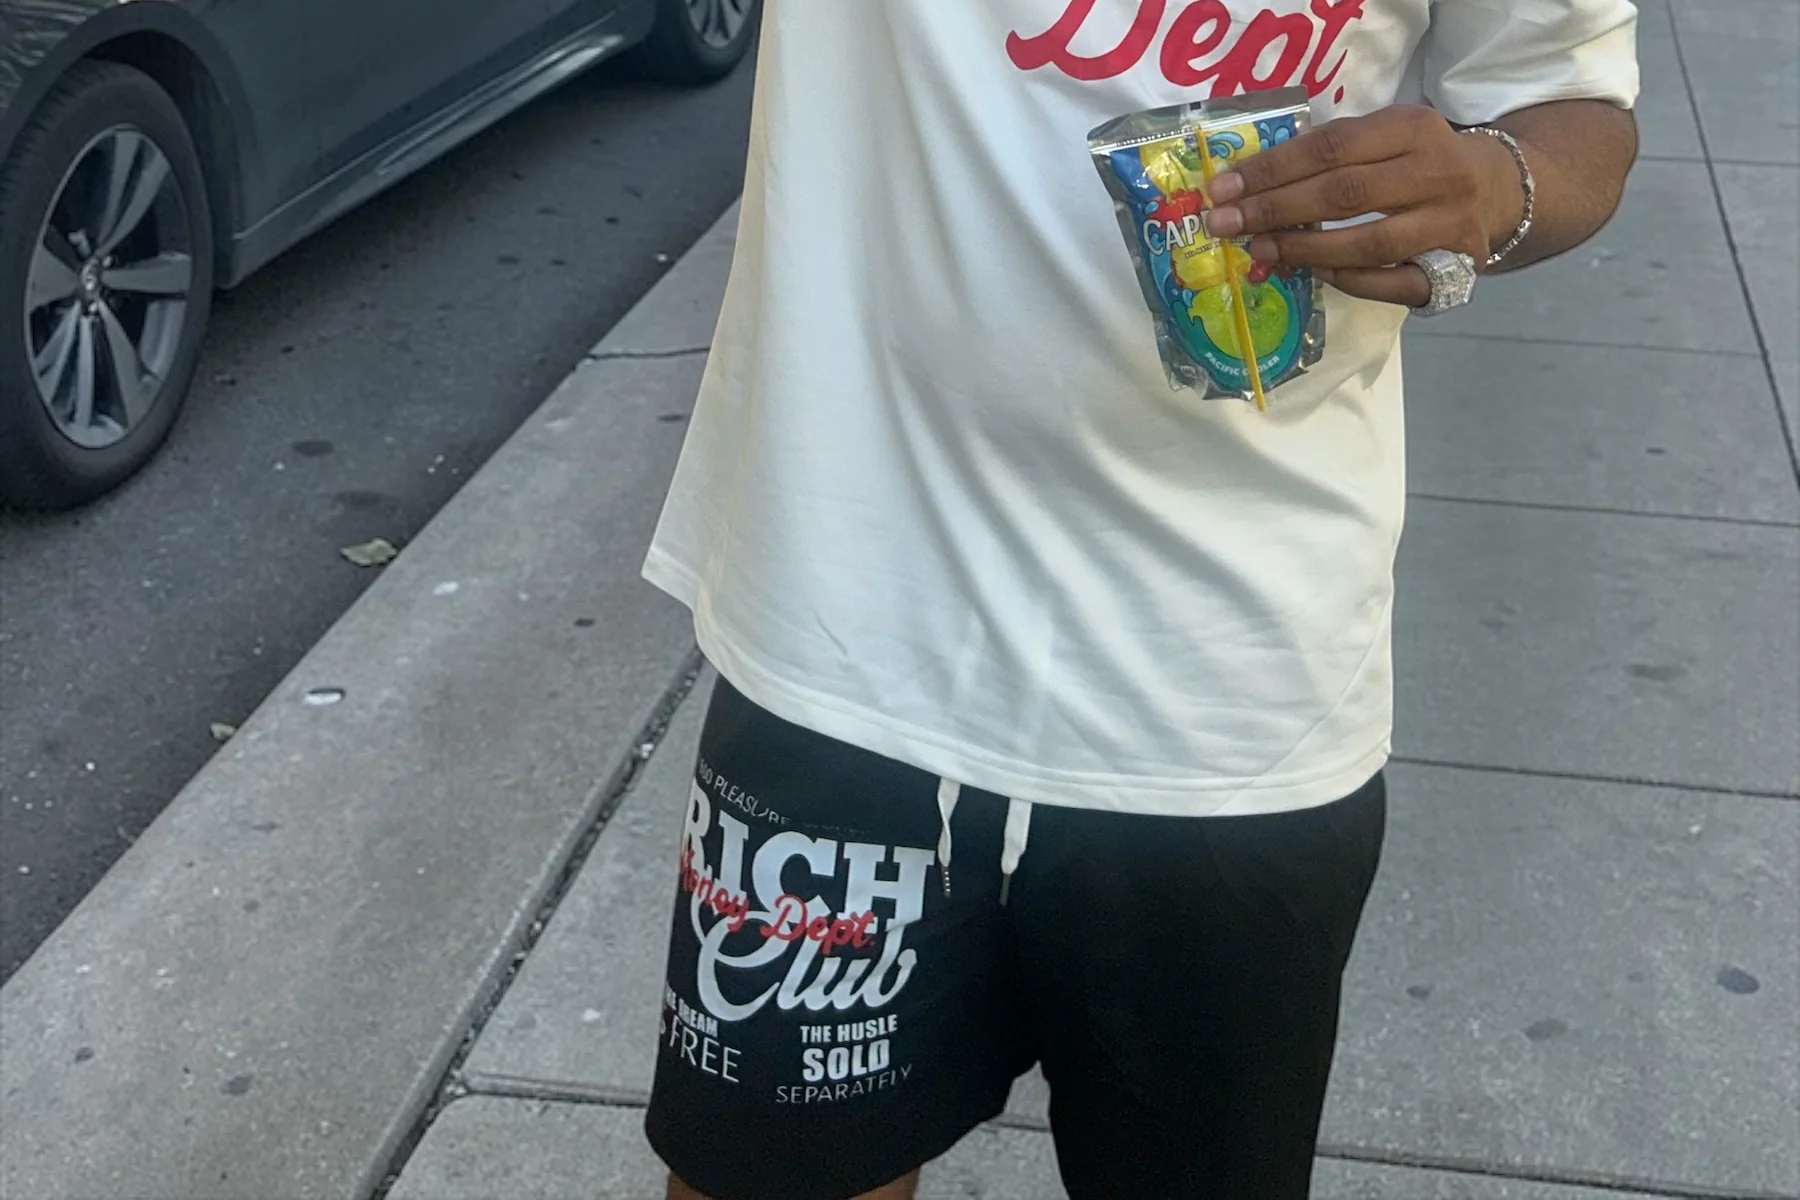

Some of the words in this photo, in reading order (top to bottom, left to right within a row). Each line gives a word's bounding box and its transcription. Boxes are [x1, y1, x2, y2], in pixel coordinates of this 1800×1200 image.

[1204, 351, 1240, 377] PACIFIC
[1242, 355, 1280, 377] COLER
[714, 774, 794, 827] PLEASURE
[680, 775, 935, 934] RICH
[690, 898, 917, 1021] Club
[669, 1014, 741, 1083] FREE
[800, 1025, 832, 1043] THE
[837, 1013, 898, 1042] HUSLE
[802, 1038, 890, 1082] SOLD
